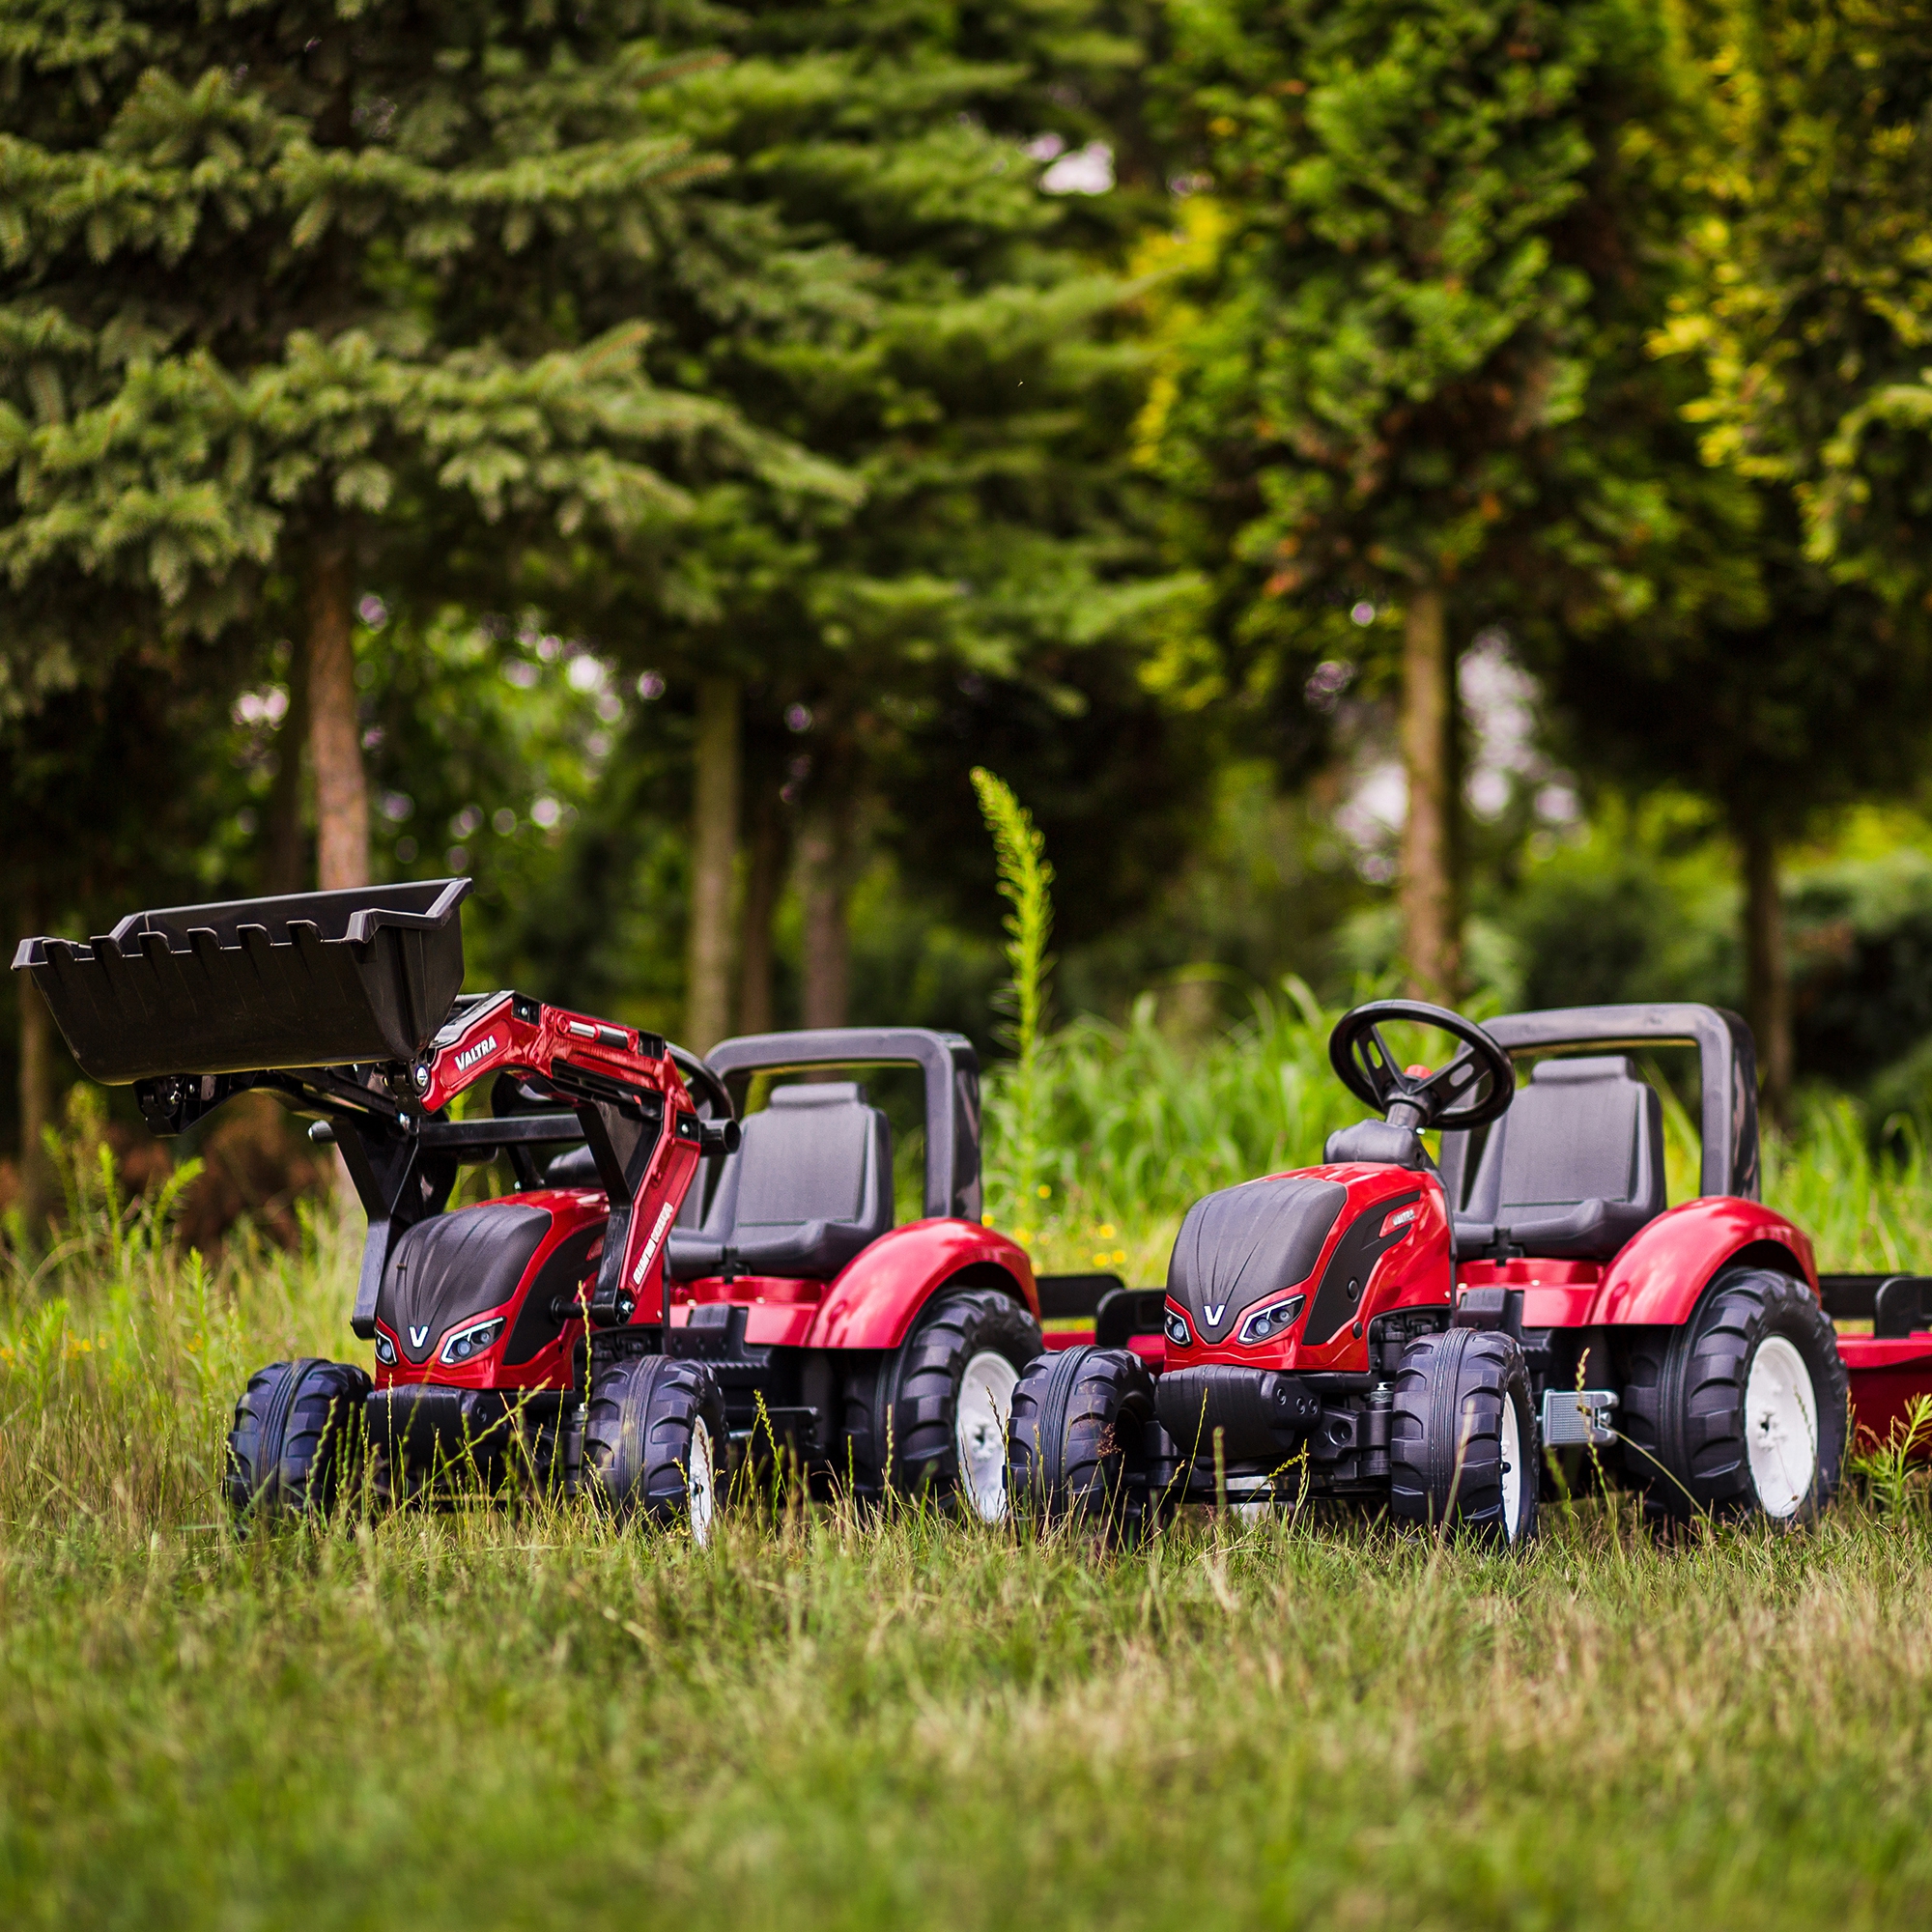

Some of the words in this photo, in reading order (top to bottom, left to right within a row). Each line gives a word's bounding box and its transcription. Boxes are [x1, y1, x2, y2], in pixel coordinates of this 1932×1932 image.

[454, 1035, 497, 1072] VALTRA
[1203, 1304, 1226, 1326] V
[409, 1325, 429, 1348] V
